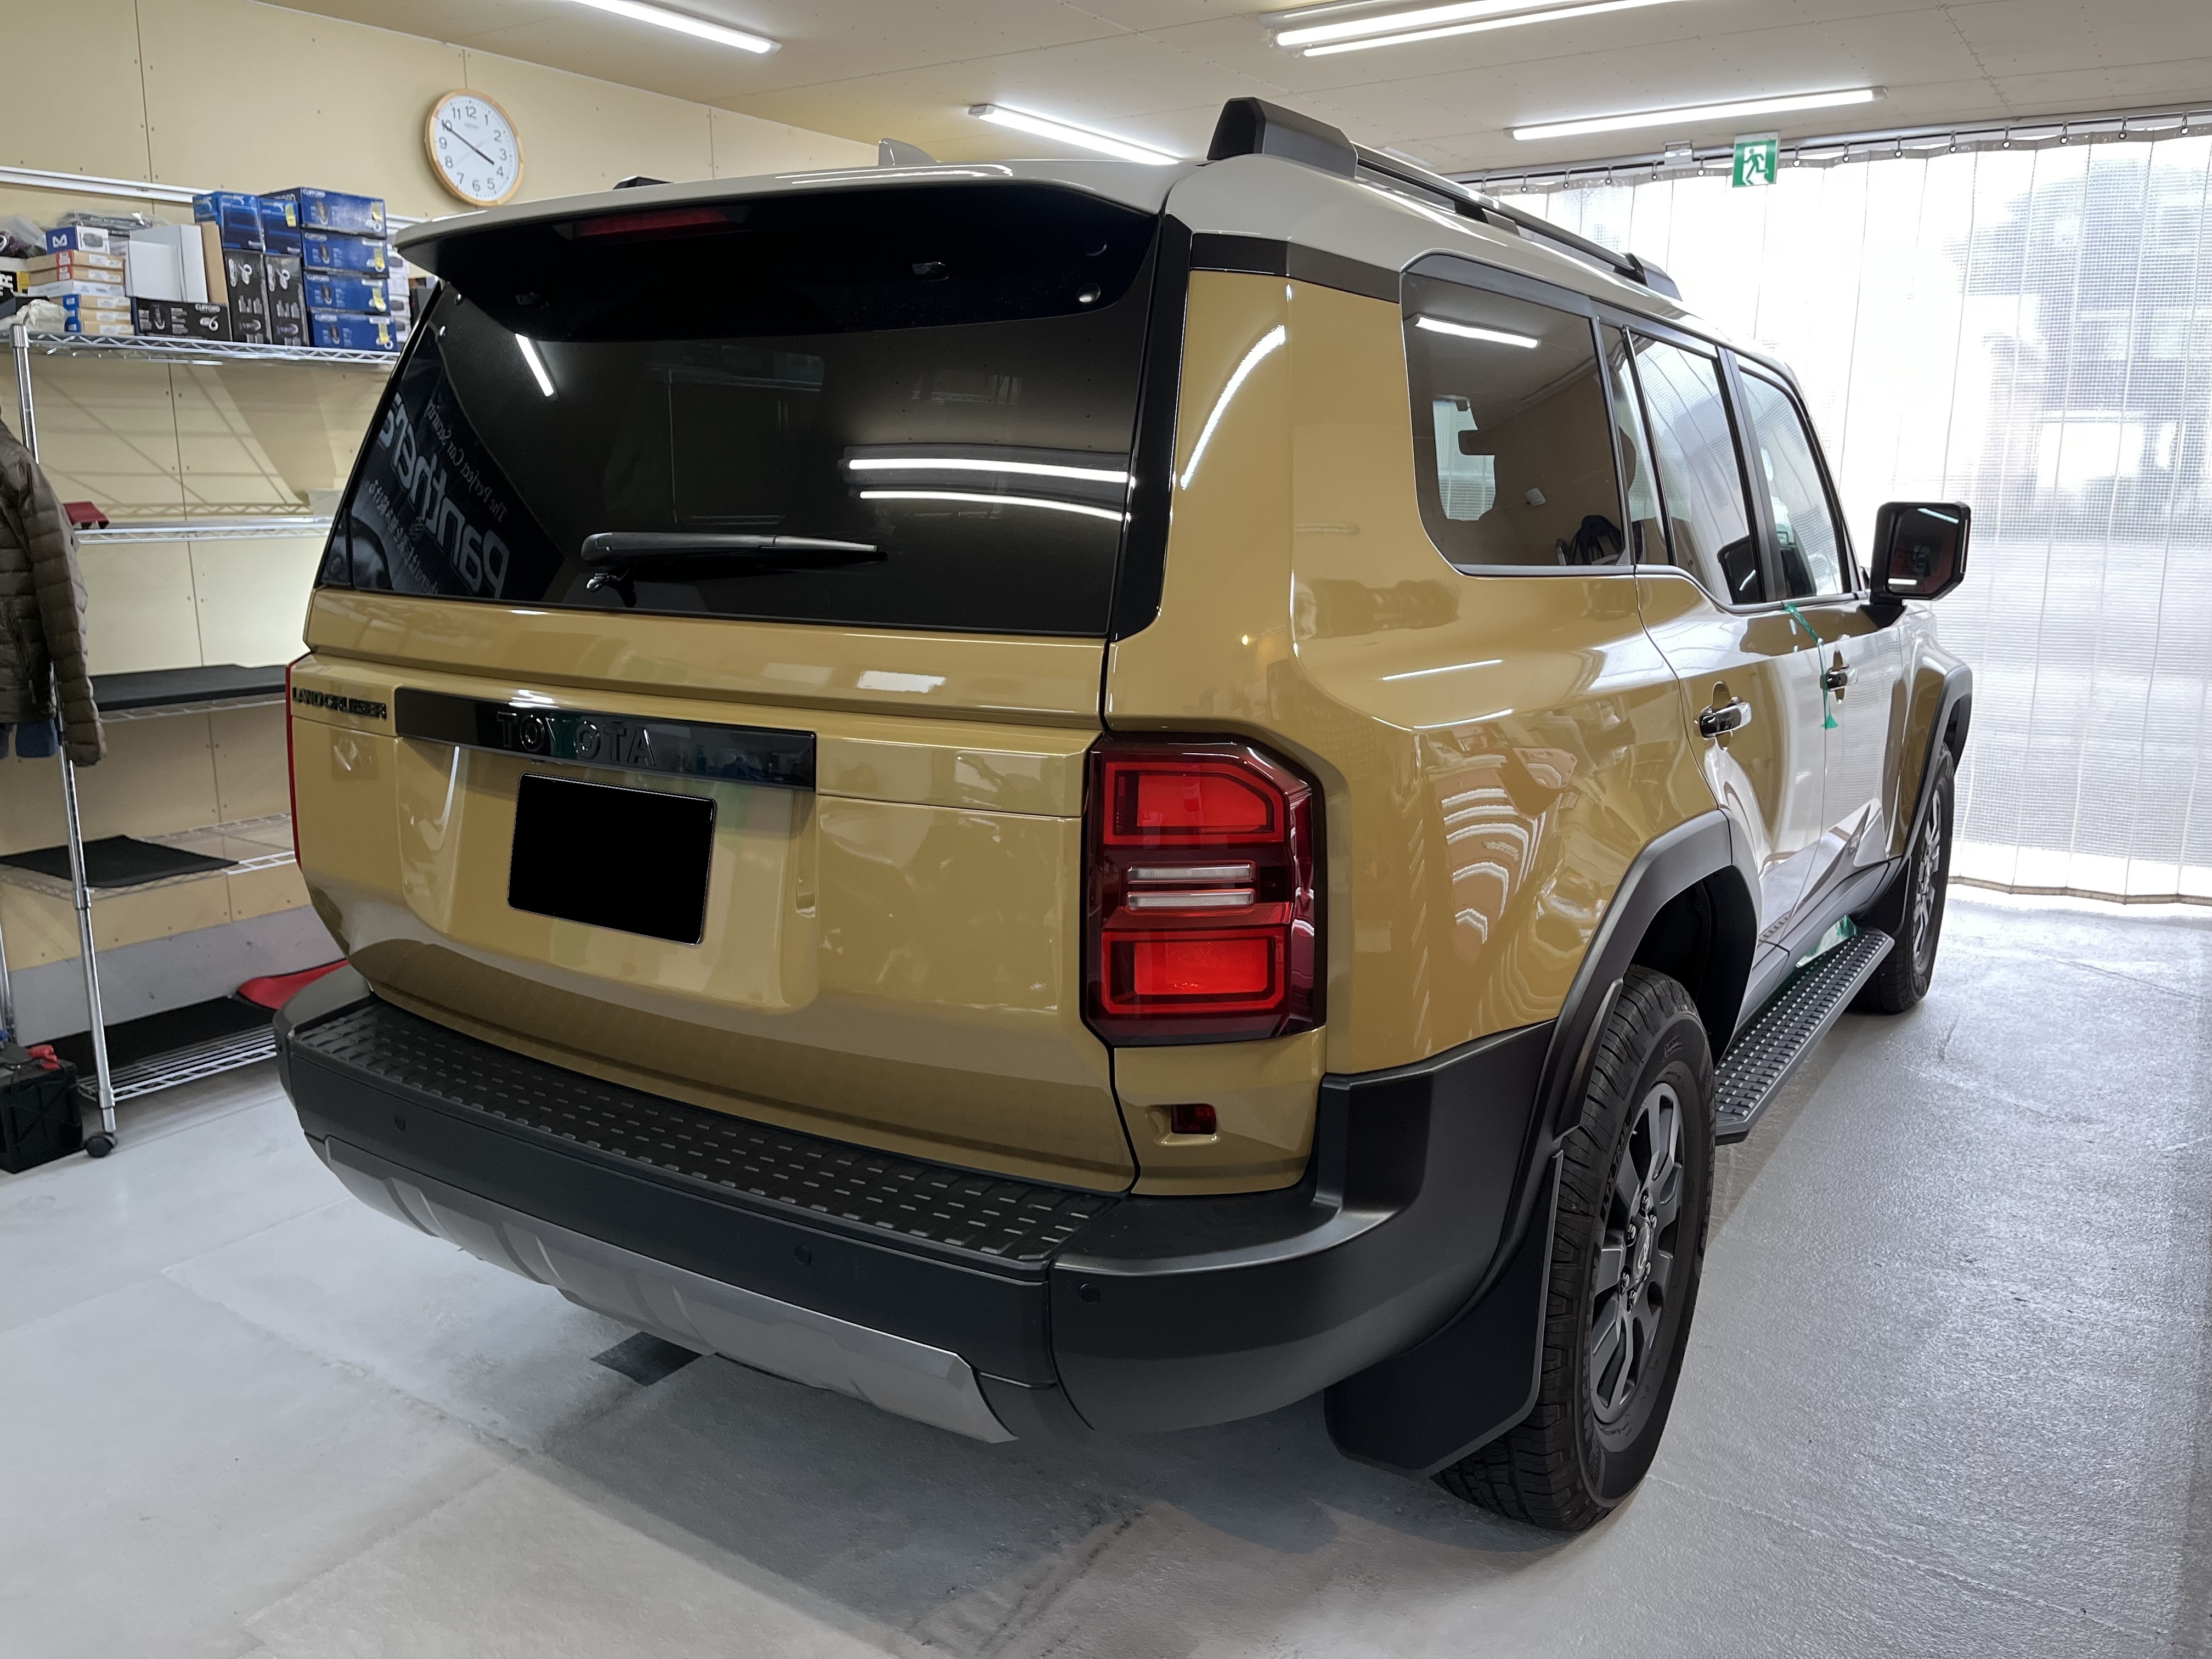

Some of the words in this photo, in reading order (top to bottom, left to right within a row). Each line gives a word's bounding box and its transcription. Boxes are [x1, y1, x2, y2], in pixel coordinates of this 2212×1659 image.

[453, 108, 461, 120] 11
[465, 106, 477, 119] 12
[439, 137, 447, 149] 9
[494, 130, 502, 143] 2
[499, 148, 507, 161] 3
[445, 156, 453, 168] 8
[456, 172, 464, 185] 7
[496, 166, 504, 178] 4
[472, 179, 481, 191] 6
[487, 178, 495, 190] 5
[292, 687, 324, 707] LAND
[324, 693, 387, 720] CRUISER
[497, 711, 658, 766] TOYOTA
[1613, 1121, 1629, 1167] TRAIL
